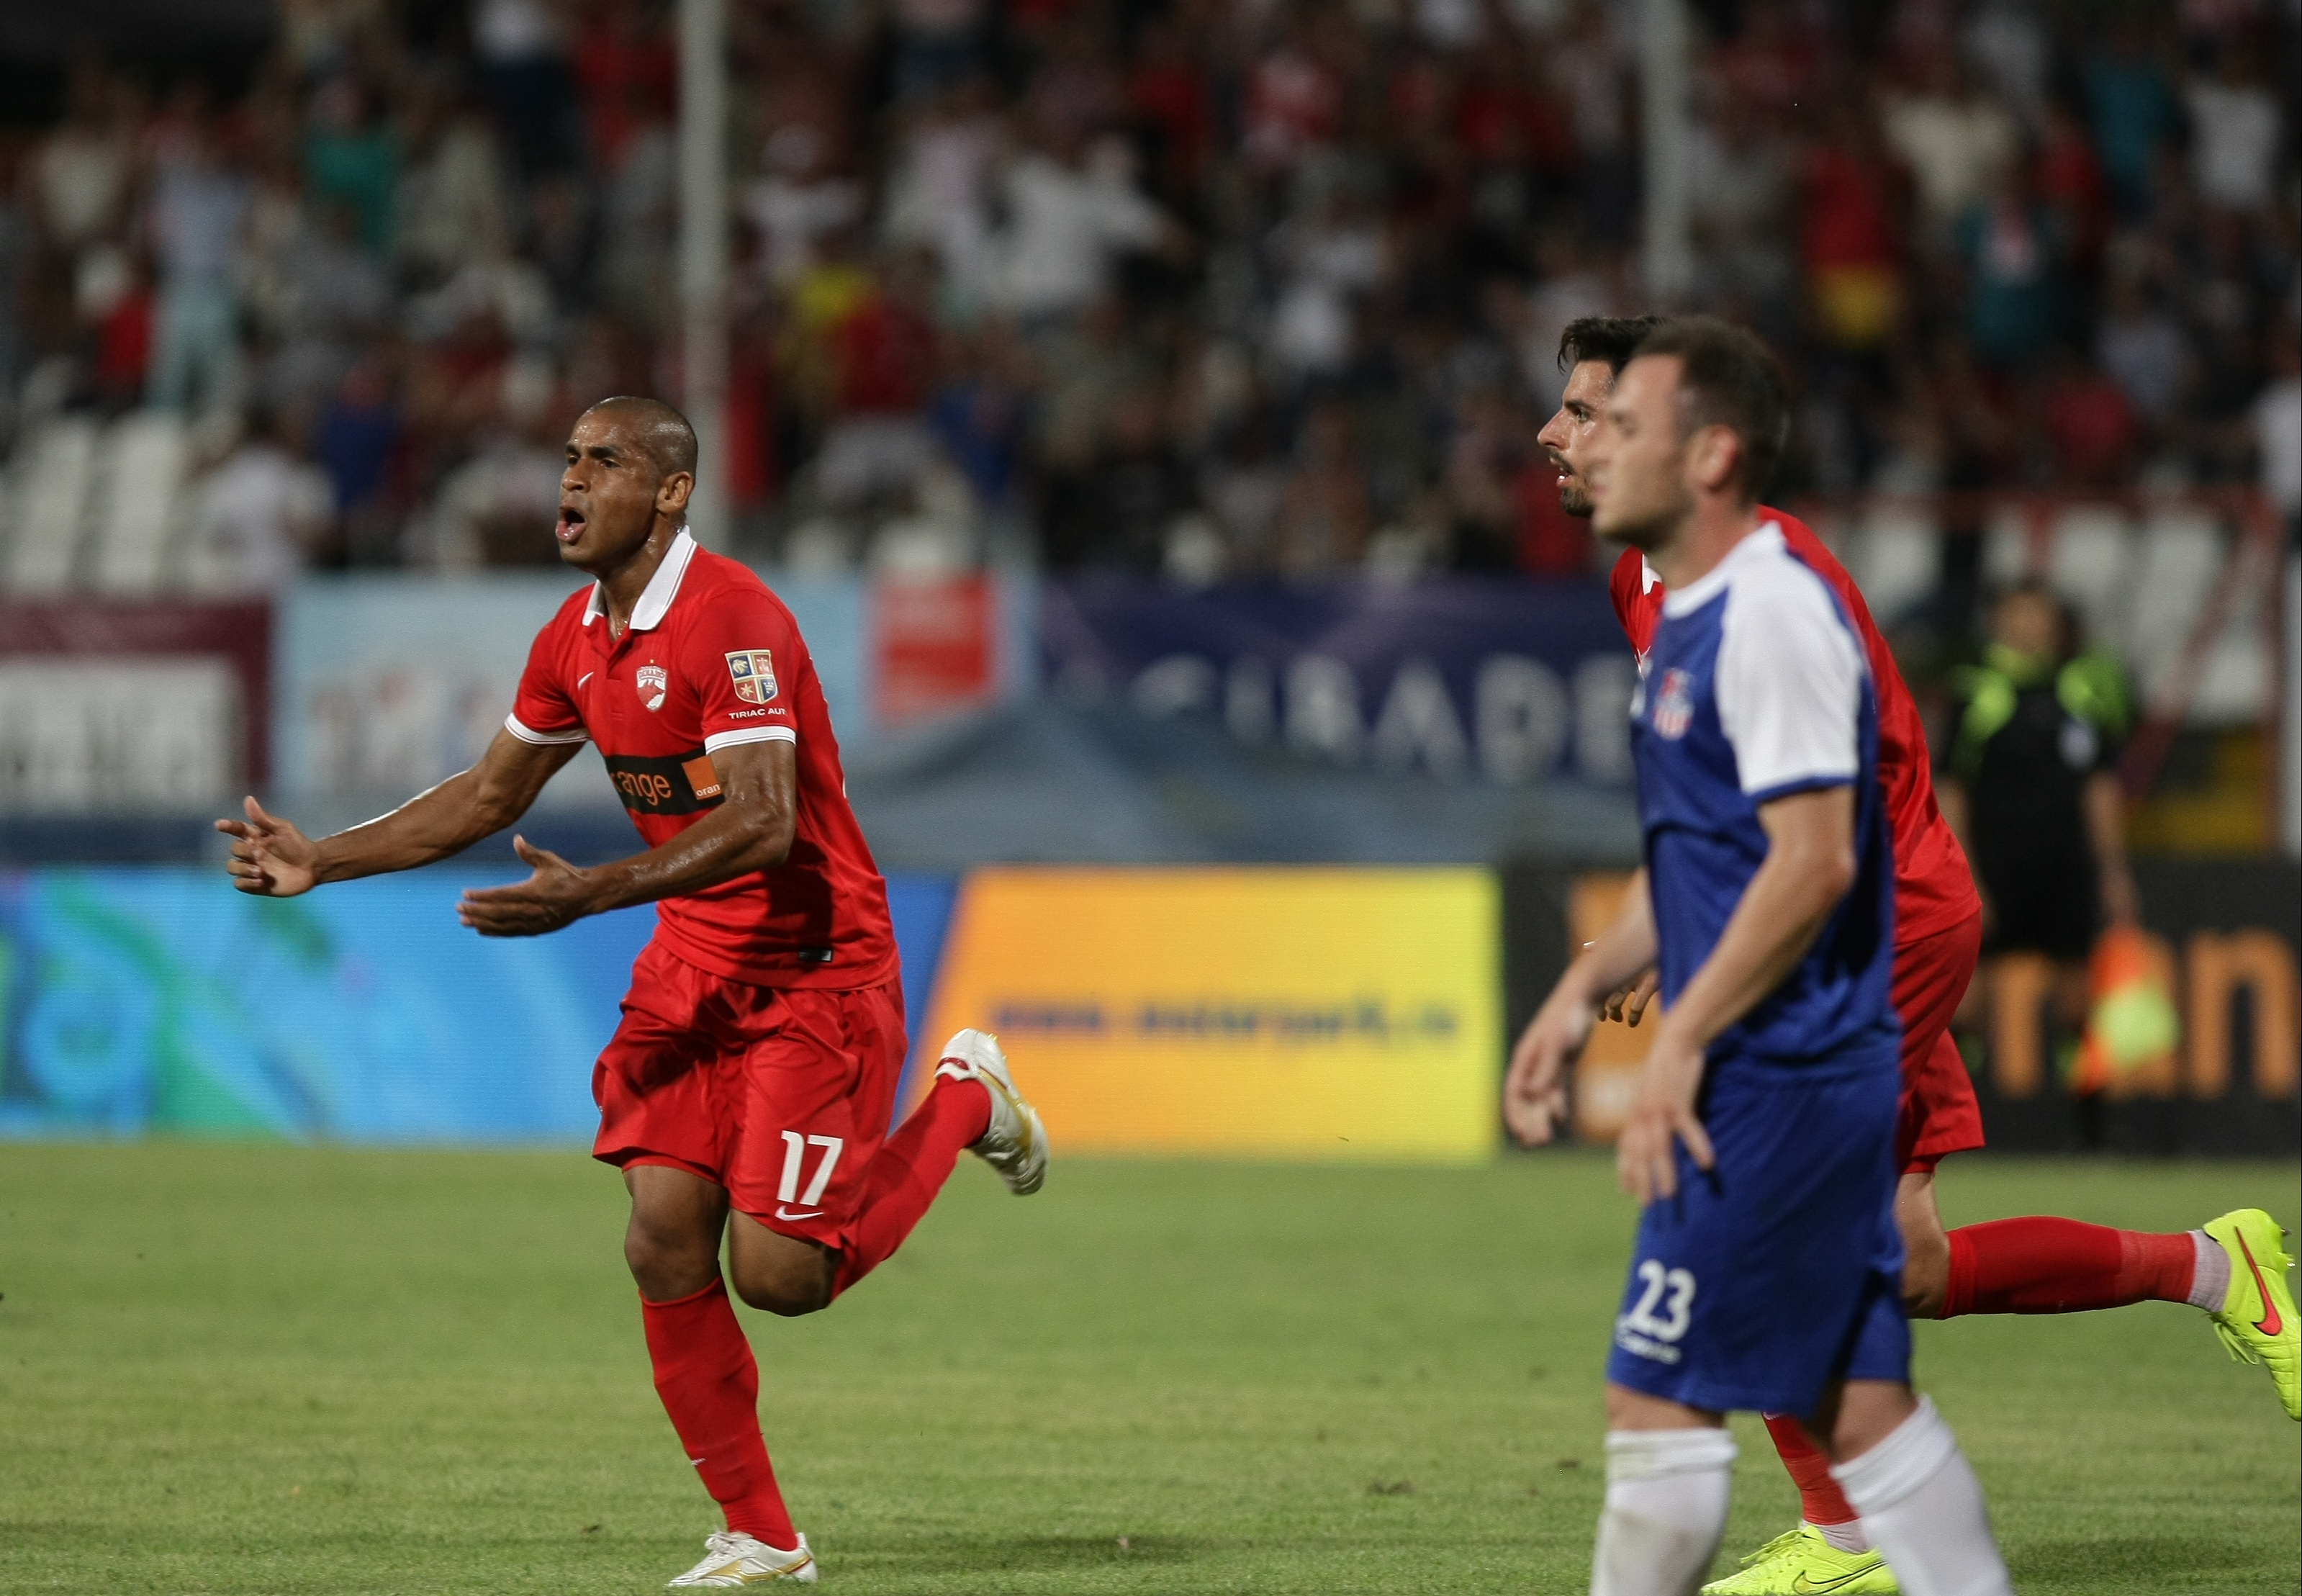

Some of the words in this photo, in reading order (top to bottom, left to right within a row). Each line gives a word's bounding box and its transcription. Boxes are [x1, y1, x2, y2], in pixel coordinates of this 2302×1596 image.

[728, 708, 766, 719] TIRIAC
[767, 708, 787, 717] AUT
[777, 1130, 843, 1207] 17
[1625, 1258, 1697, 1343] 23
